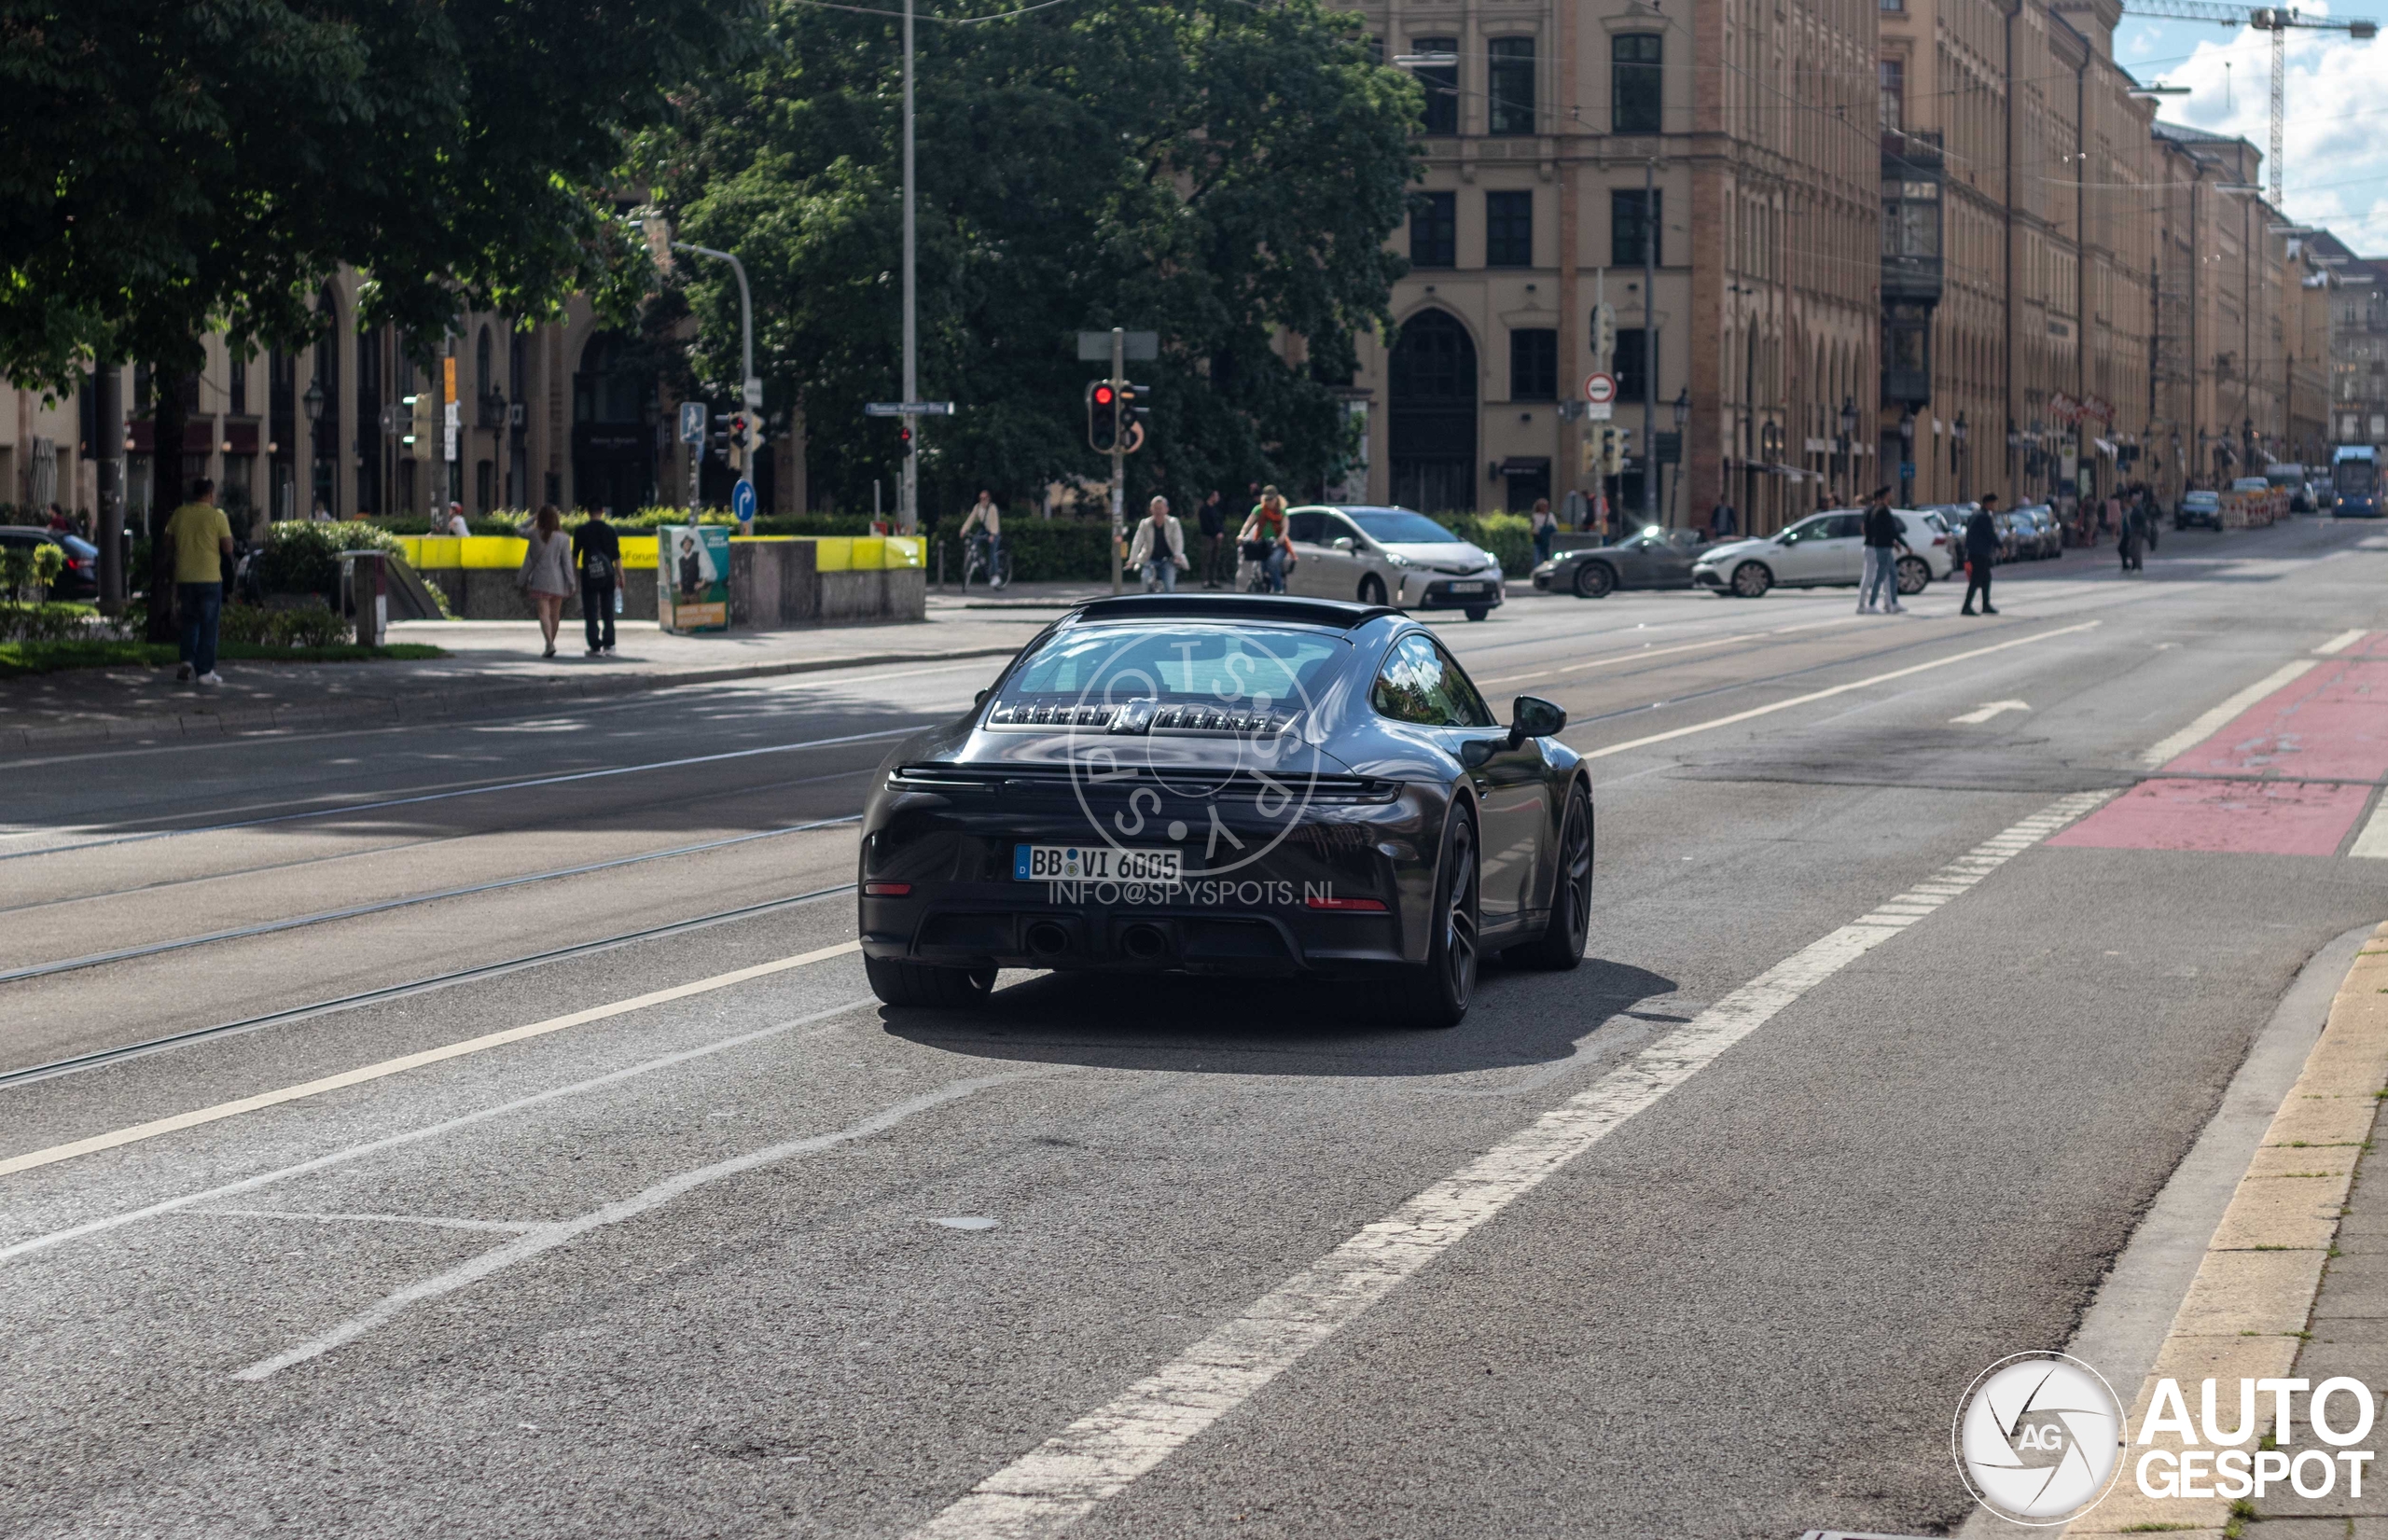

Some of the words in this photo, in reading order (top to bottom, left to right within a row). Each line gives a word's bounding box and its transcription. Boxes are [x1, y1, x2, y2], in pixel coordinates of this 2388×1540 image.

[1019, 866, 1026, 874] D
[1031, 849, 1062, 877] BB
[1082, 850, 1109, 878] VI
[1118, 853, 1177, 880] 6005
